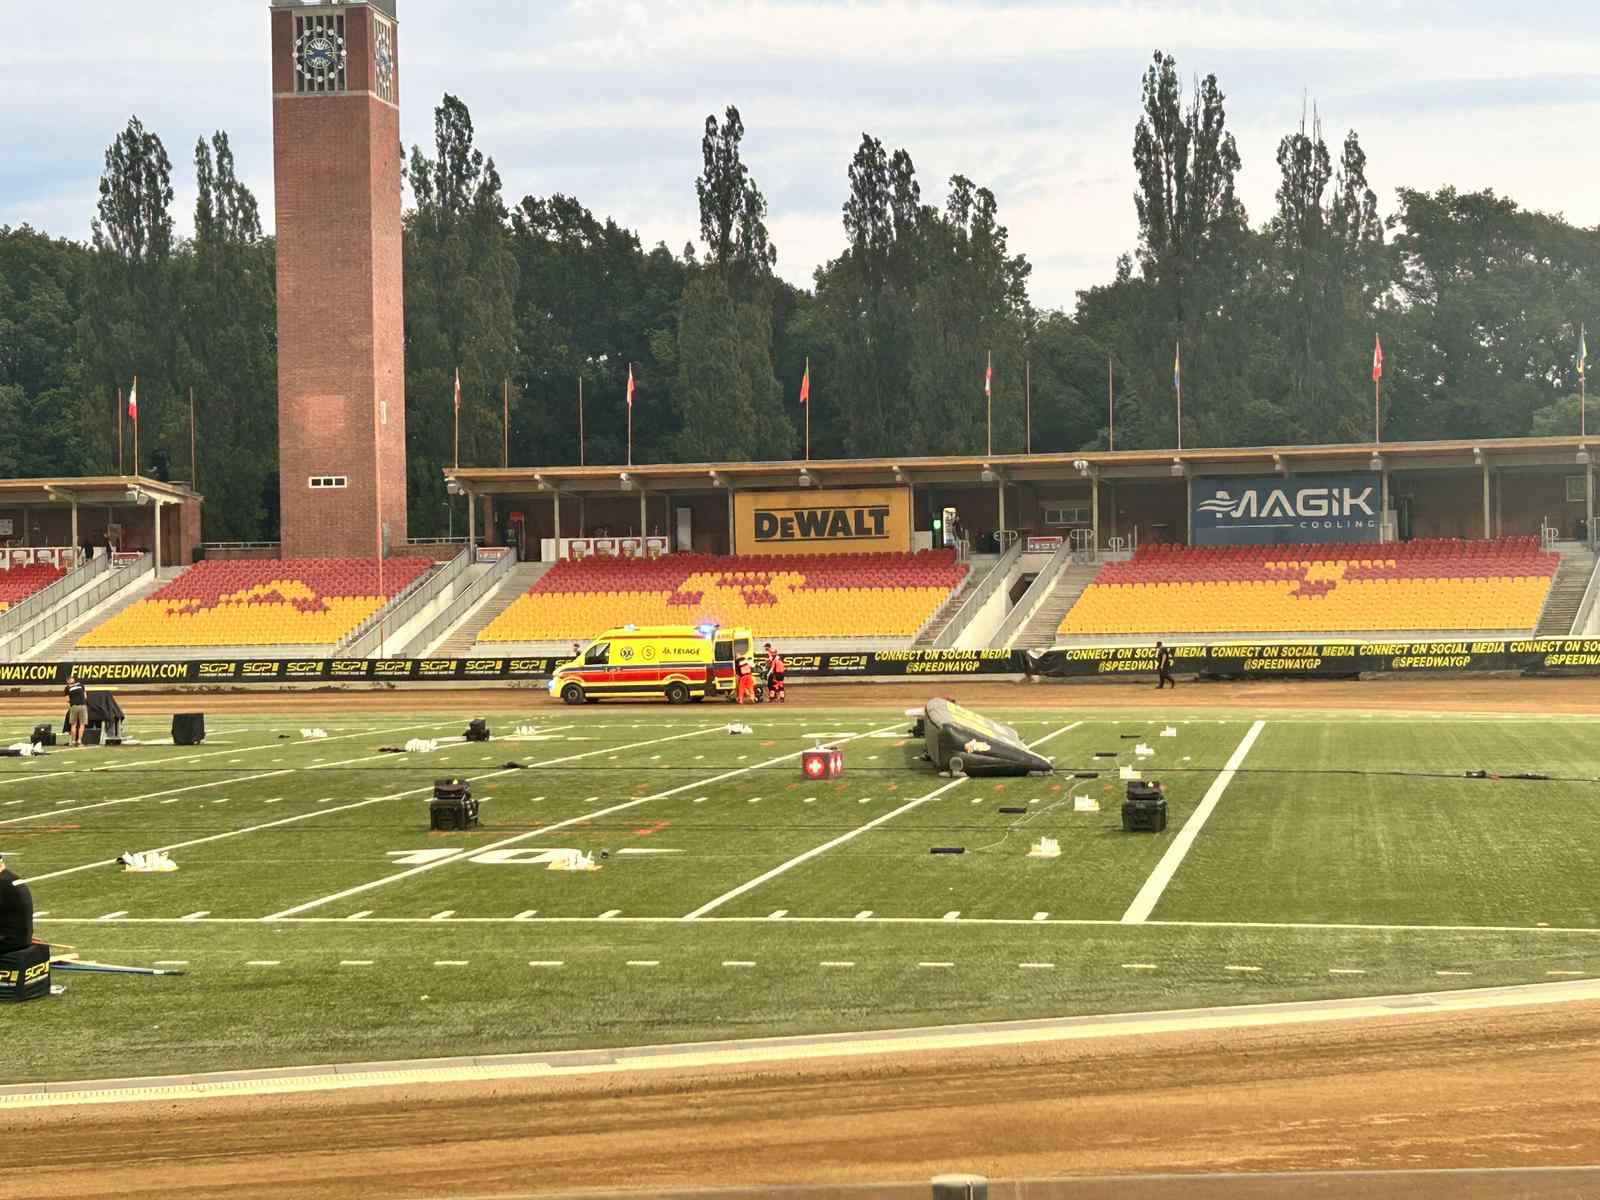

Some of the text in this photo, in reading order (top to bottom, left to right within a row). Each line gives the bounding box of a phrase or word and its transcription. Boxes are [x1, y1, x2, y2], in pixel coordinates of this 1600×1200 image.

[1300, 520, 1376, 529] COOLING
[1066, 648, 1116, 660] CONNECT
[1117, 648, 1131, 659] ON
[1175, 647, 1207, 657] MEDIA
[1211, 646, 1355, 657] CONNECT ON SOCIAL MEDIA
[1360, 643, 1505, 656] CONNECT ON SOCIAL MEDIA
[1510, 641, 1562, 653] CONNECT
[1564, 641, 1580, 652] ON
[875, 648, 1012, 661] CONNECT ON SOCIAL MEDIA
[906, 660, 980, 673] @SPEEDWAYGP
[1244, 659, 1322, 671] @SPEEDWAYGP
[1392, 656, 1471, 669] @SPEEDWAYGP
[0, 666, 57, 679] WAY.COM
[71, 664, 187, 678] FIMSPEEDWAY.COM
